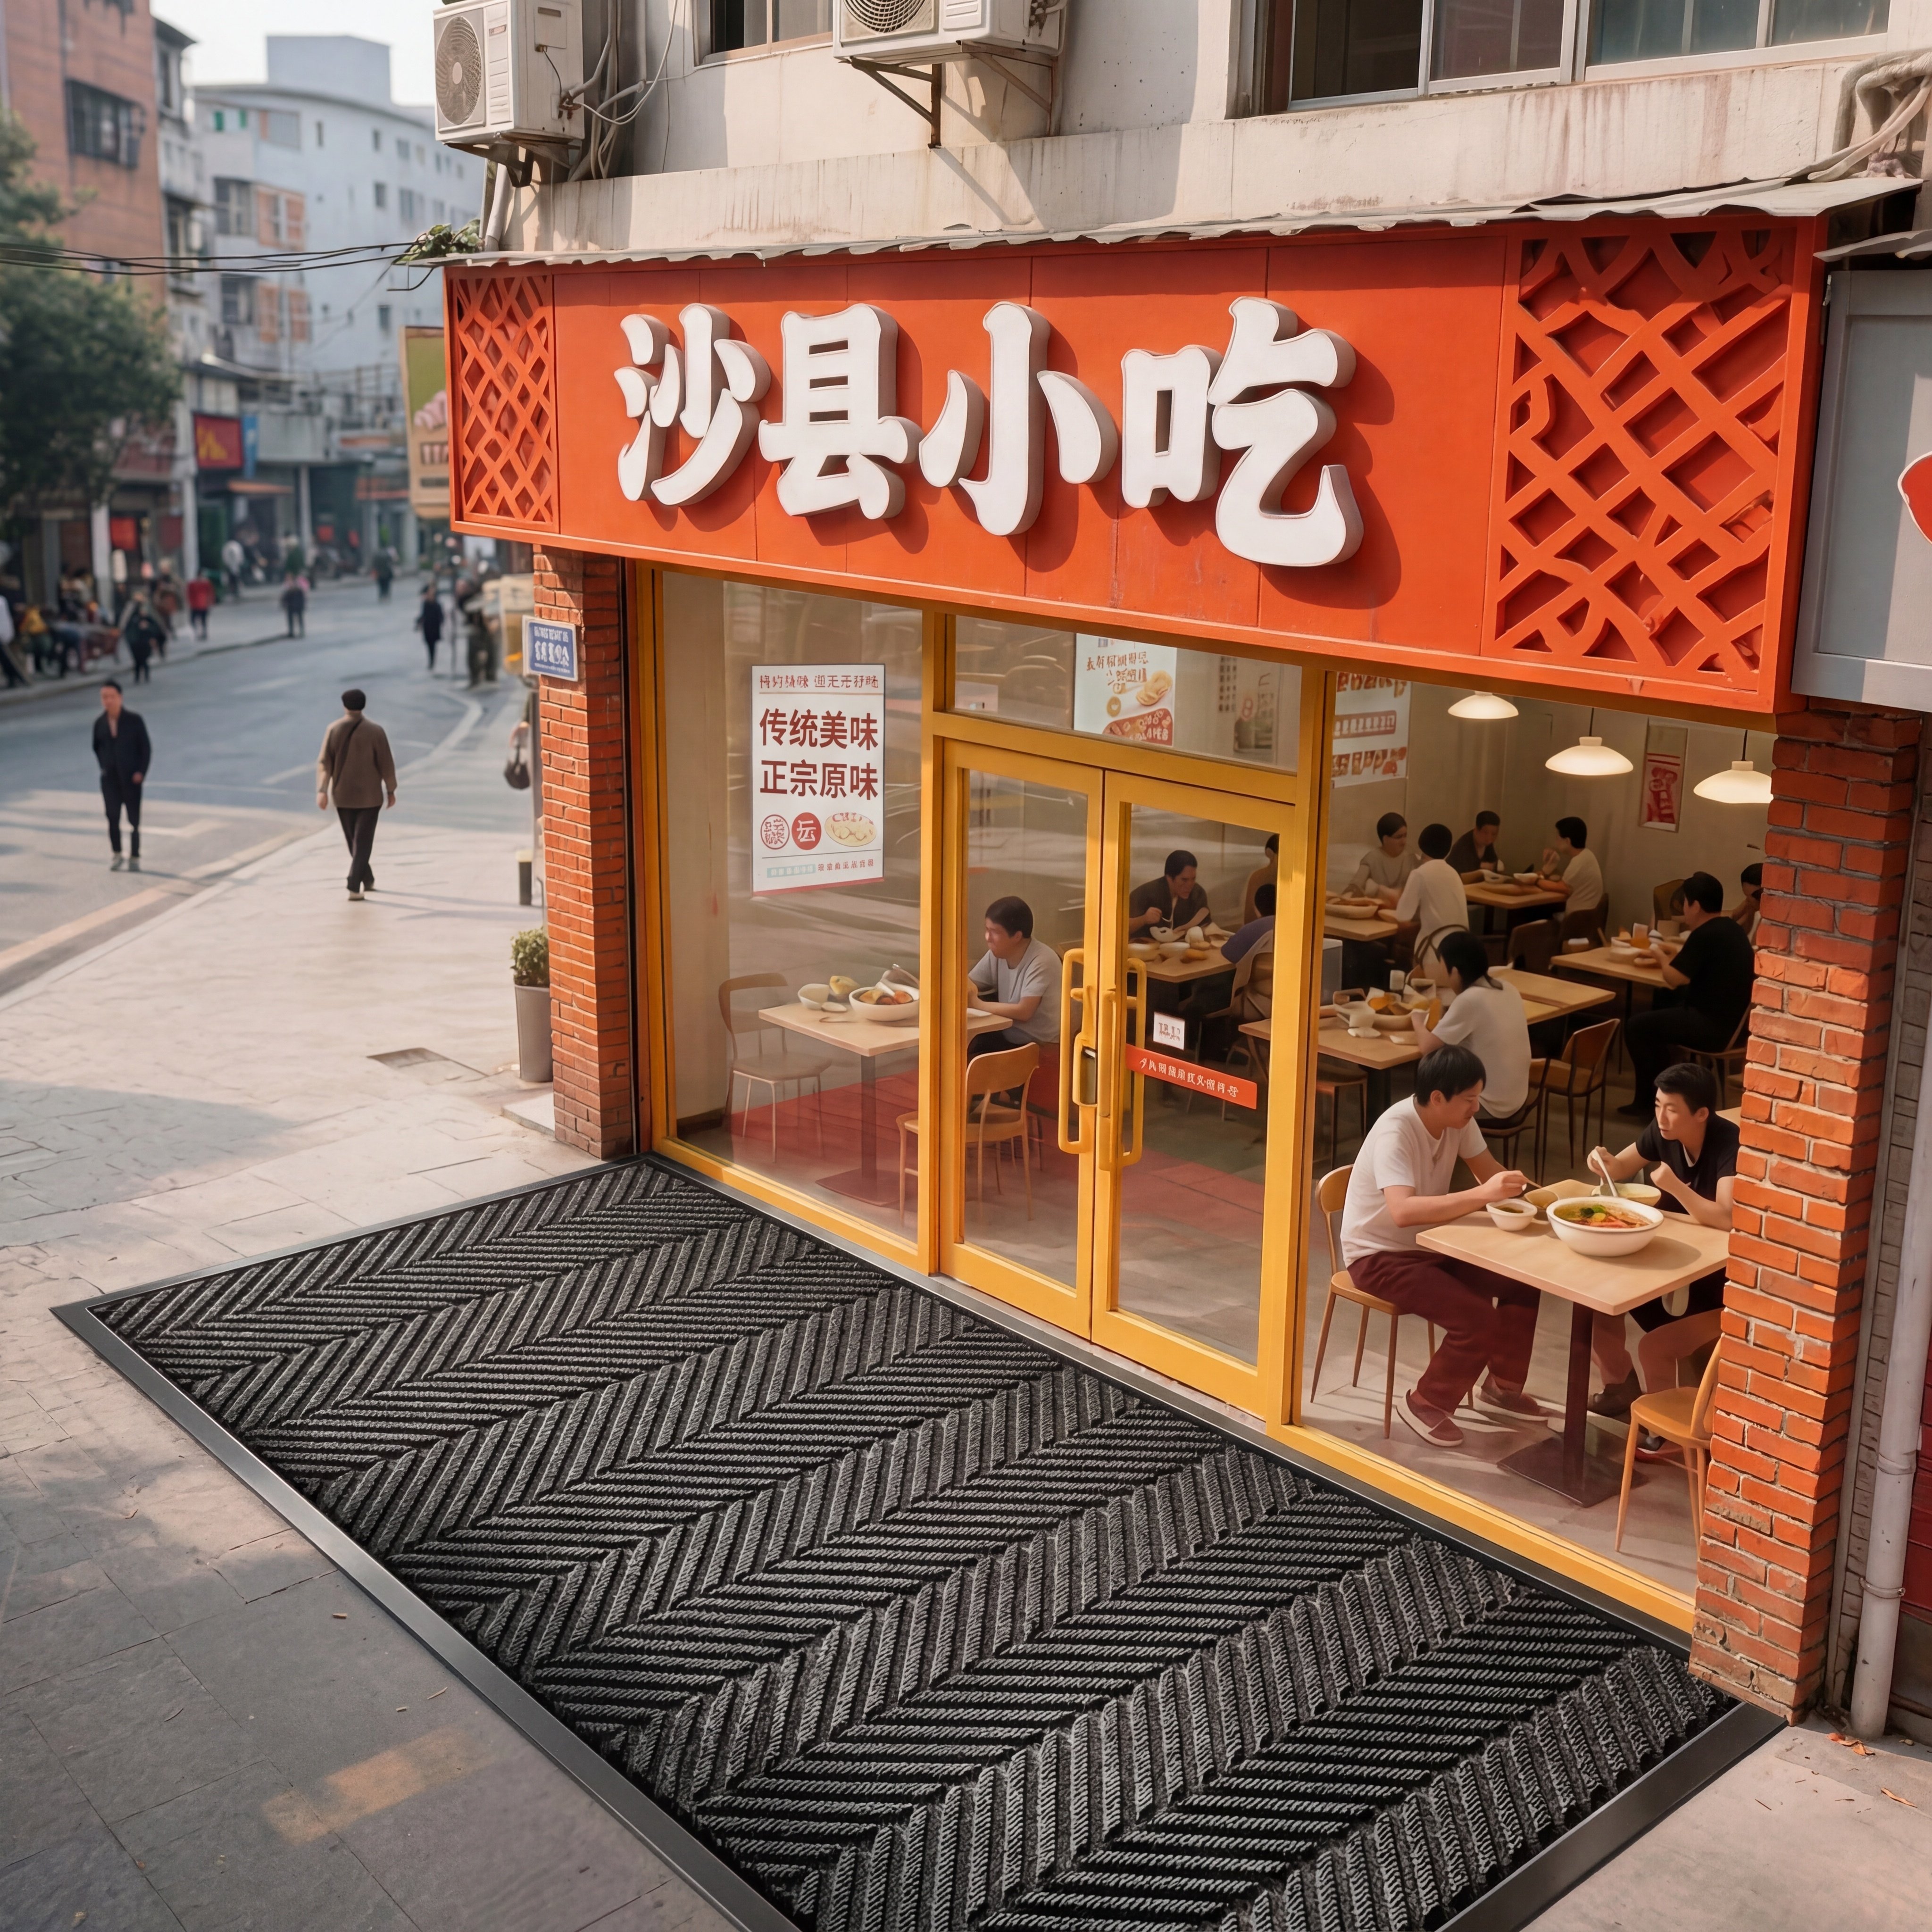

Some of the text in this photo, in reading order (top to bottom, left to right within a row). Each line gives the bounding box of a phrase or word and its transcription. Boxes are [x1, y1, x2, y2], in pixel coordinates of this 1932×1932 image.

[614, 297, 1362, 567] 沙县小吃
[759, 708, 878, 750] 传统美味
[760, 759, 878, 800] 正宗原味
